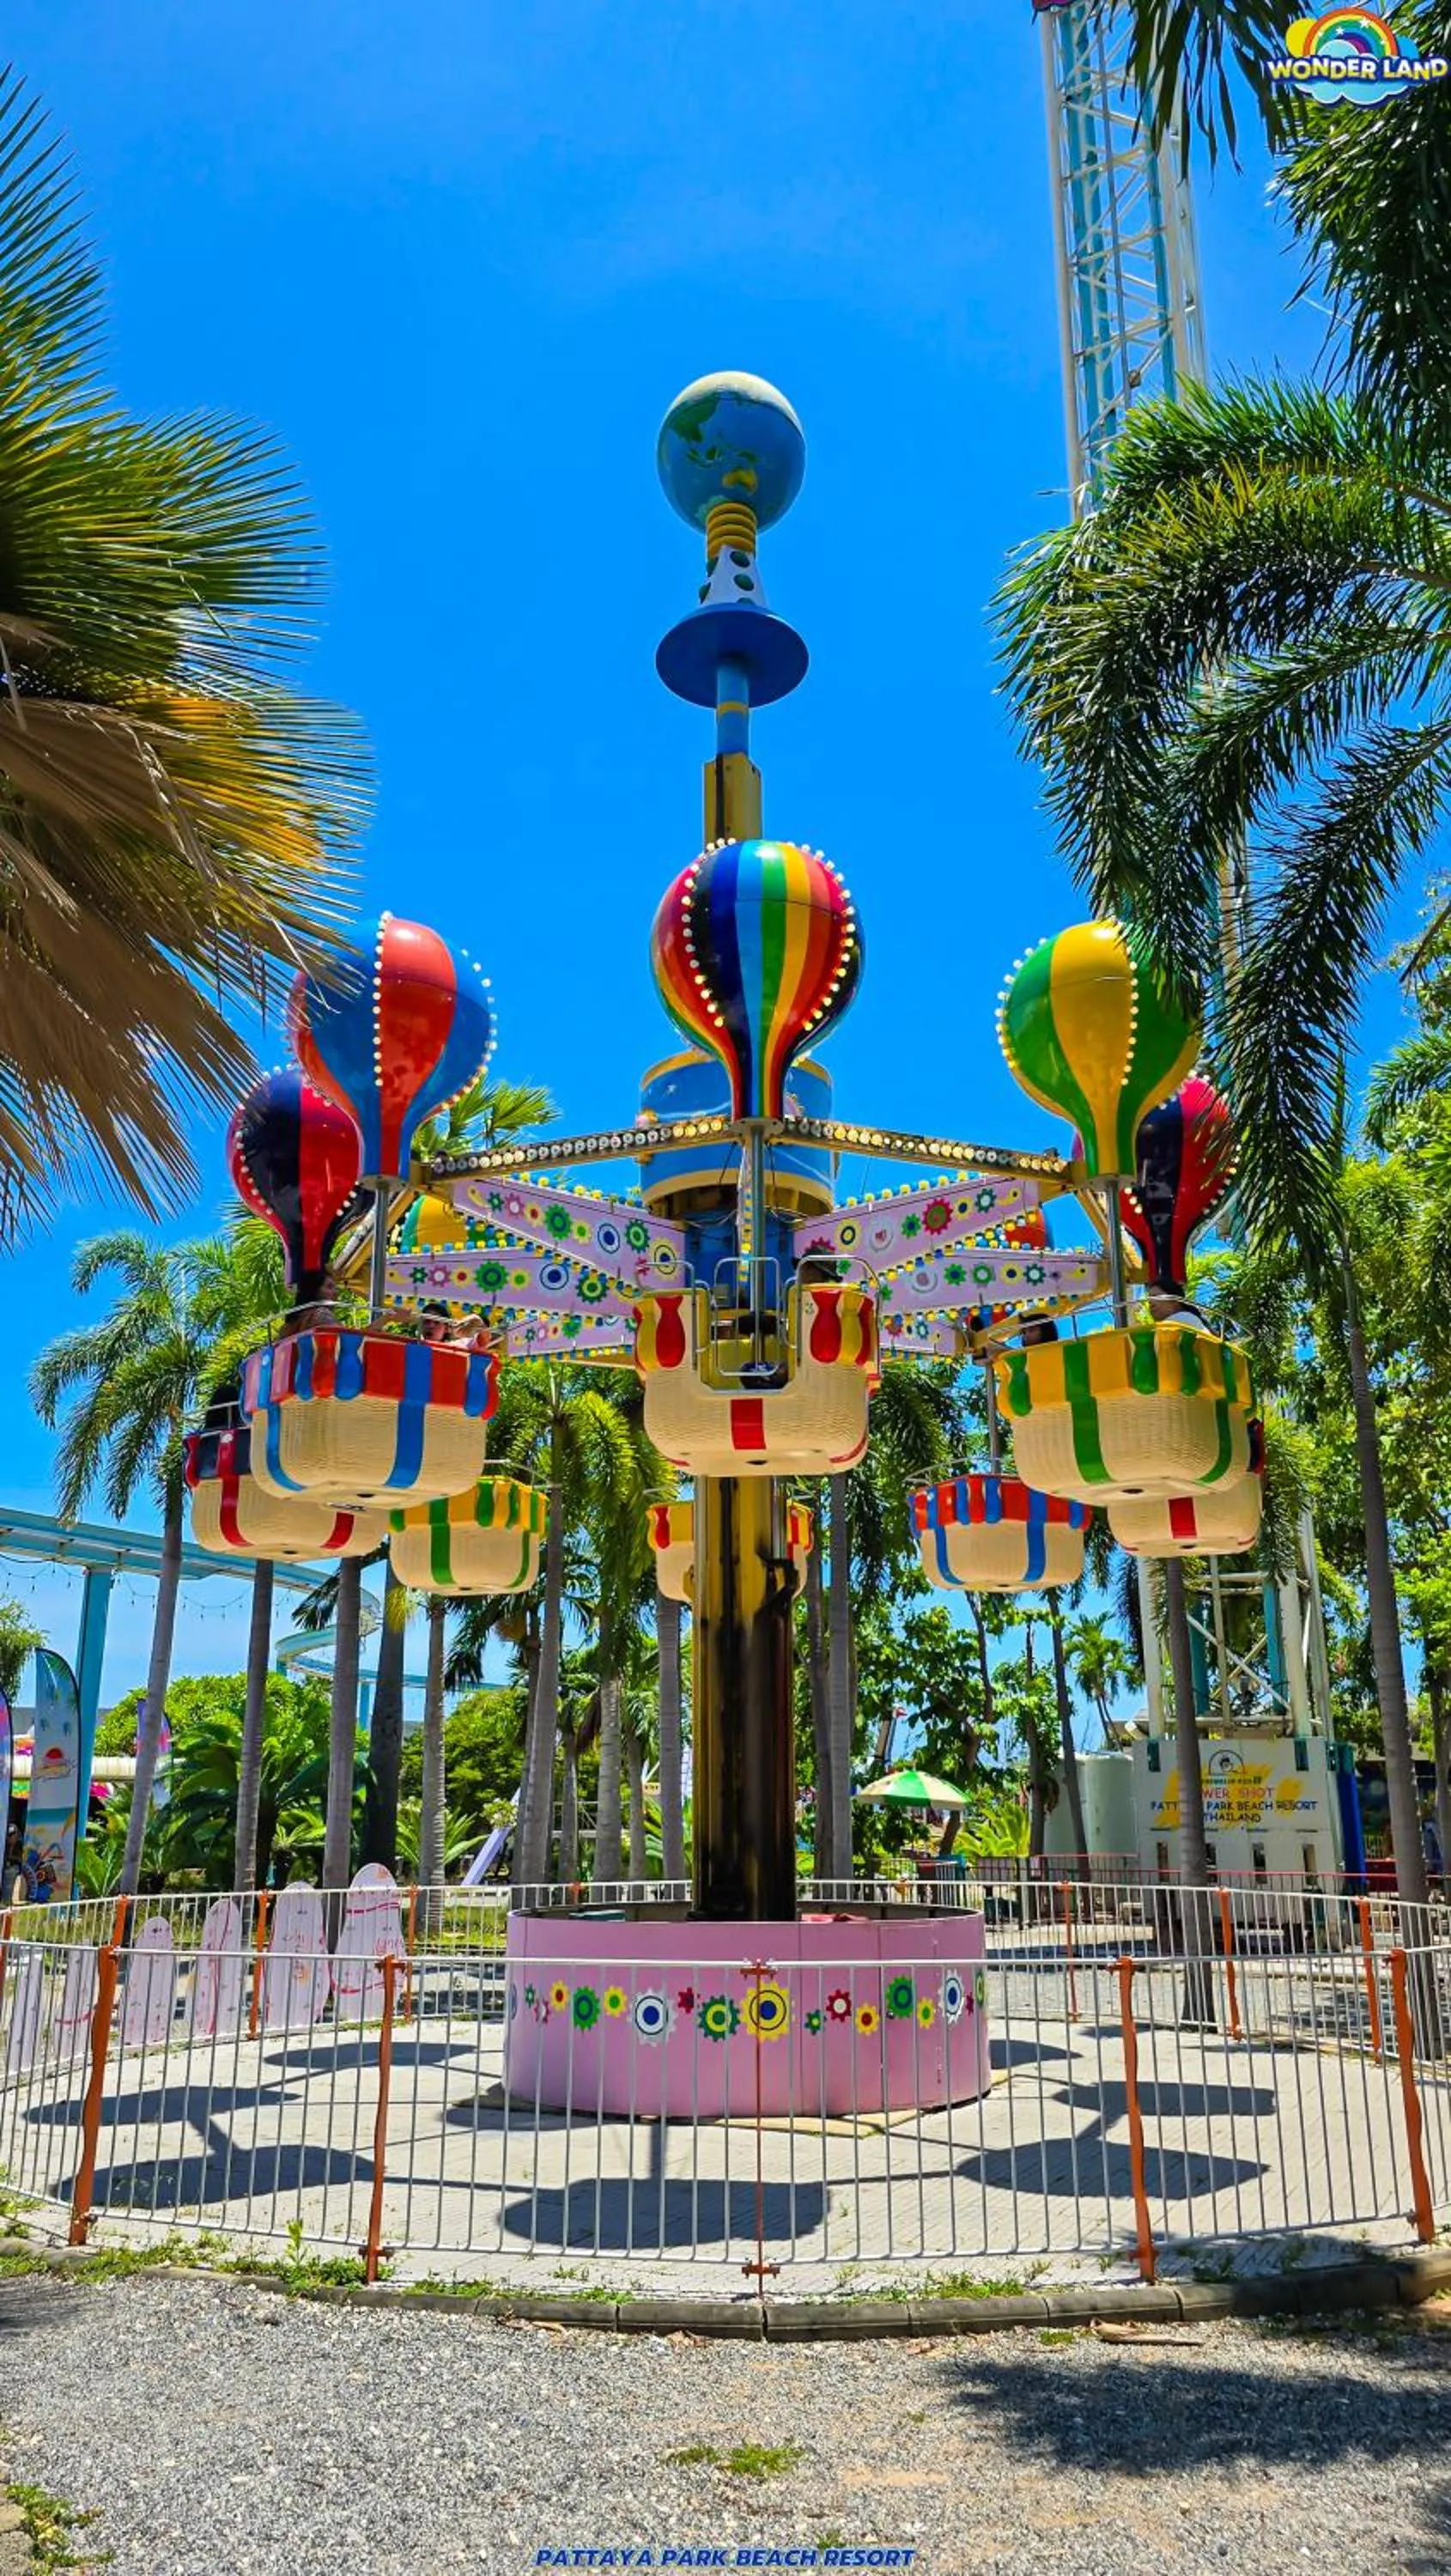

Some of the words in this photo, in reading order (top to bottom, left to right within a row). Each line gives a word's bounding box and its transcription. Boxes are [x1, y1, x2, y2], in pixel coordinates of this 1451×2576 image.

[1206, 1801, 1232, 1811] PARK
[1236, 1801, 1273, 1811] BEACH
[1276, 1800, 1319, 1811] RESORT
[1203, 1812, 1261, 1823] THAILAND
